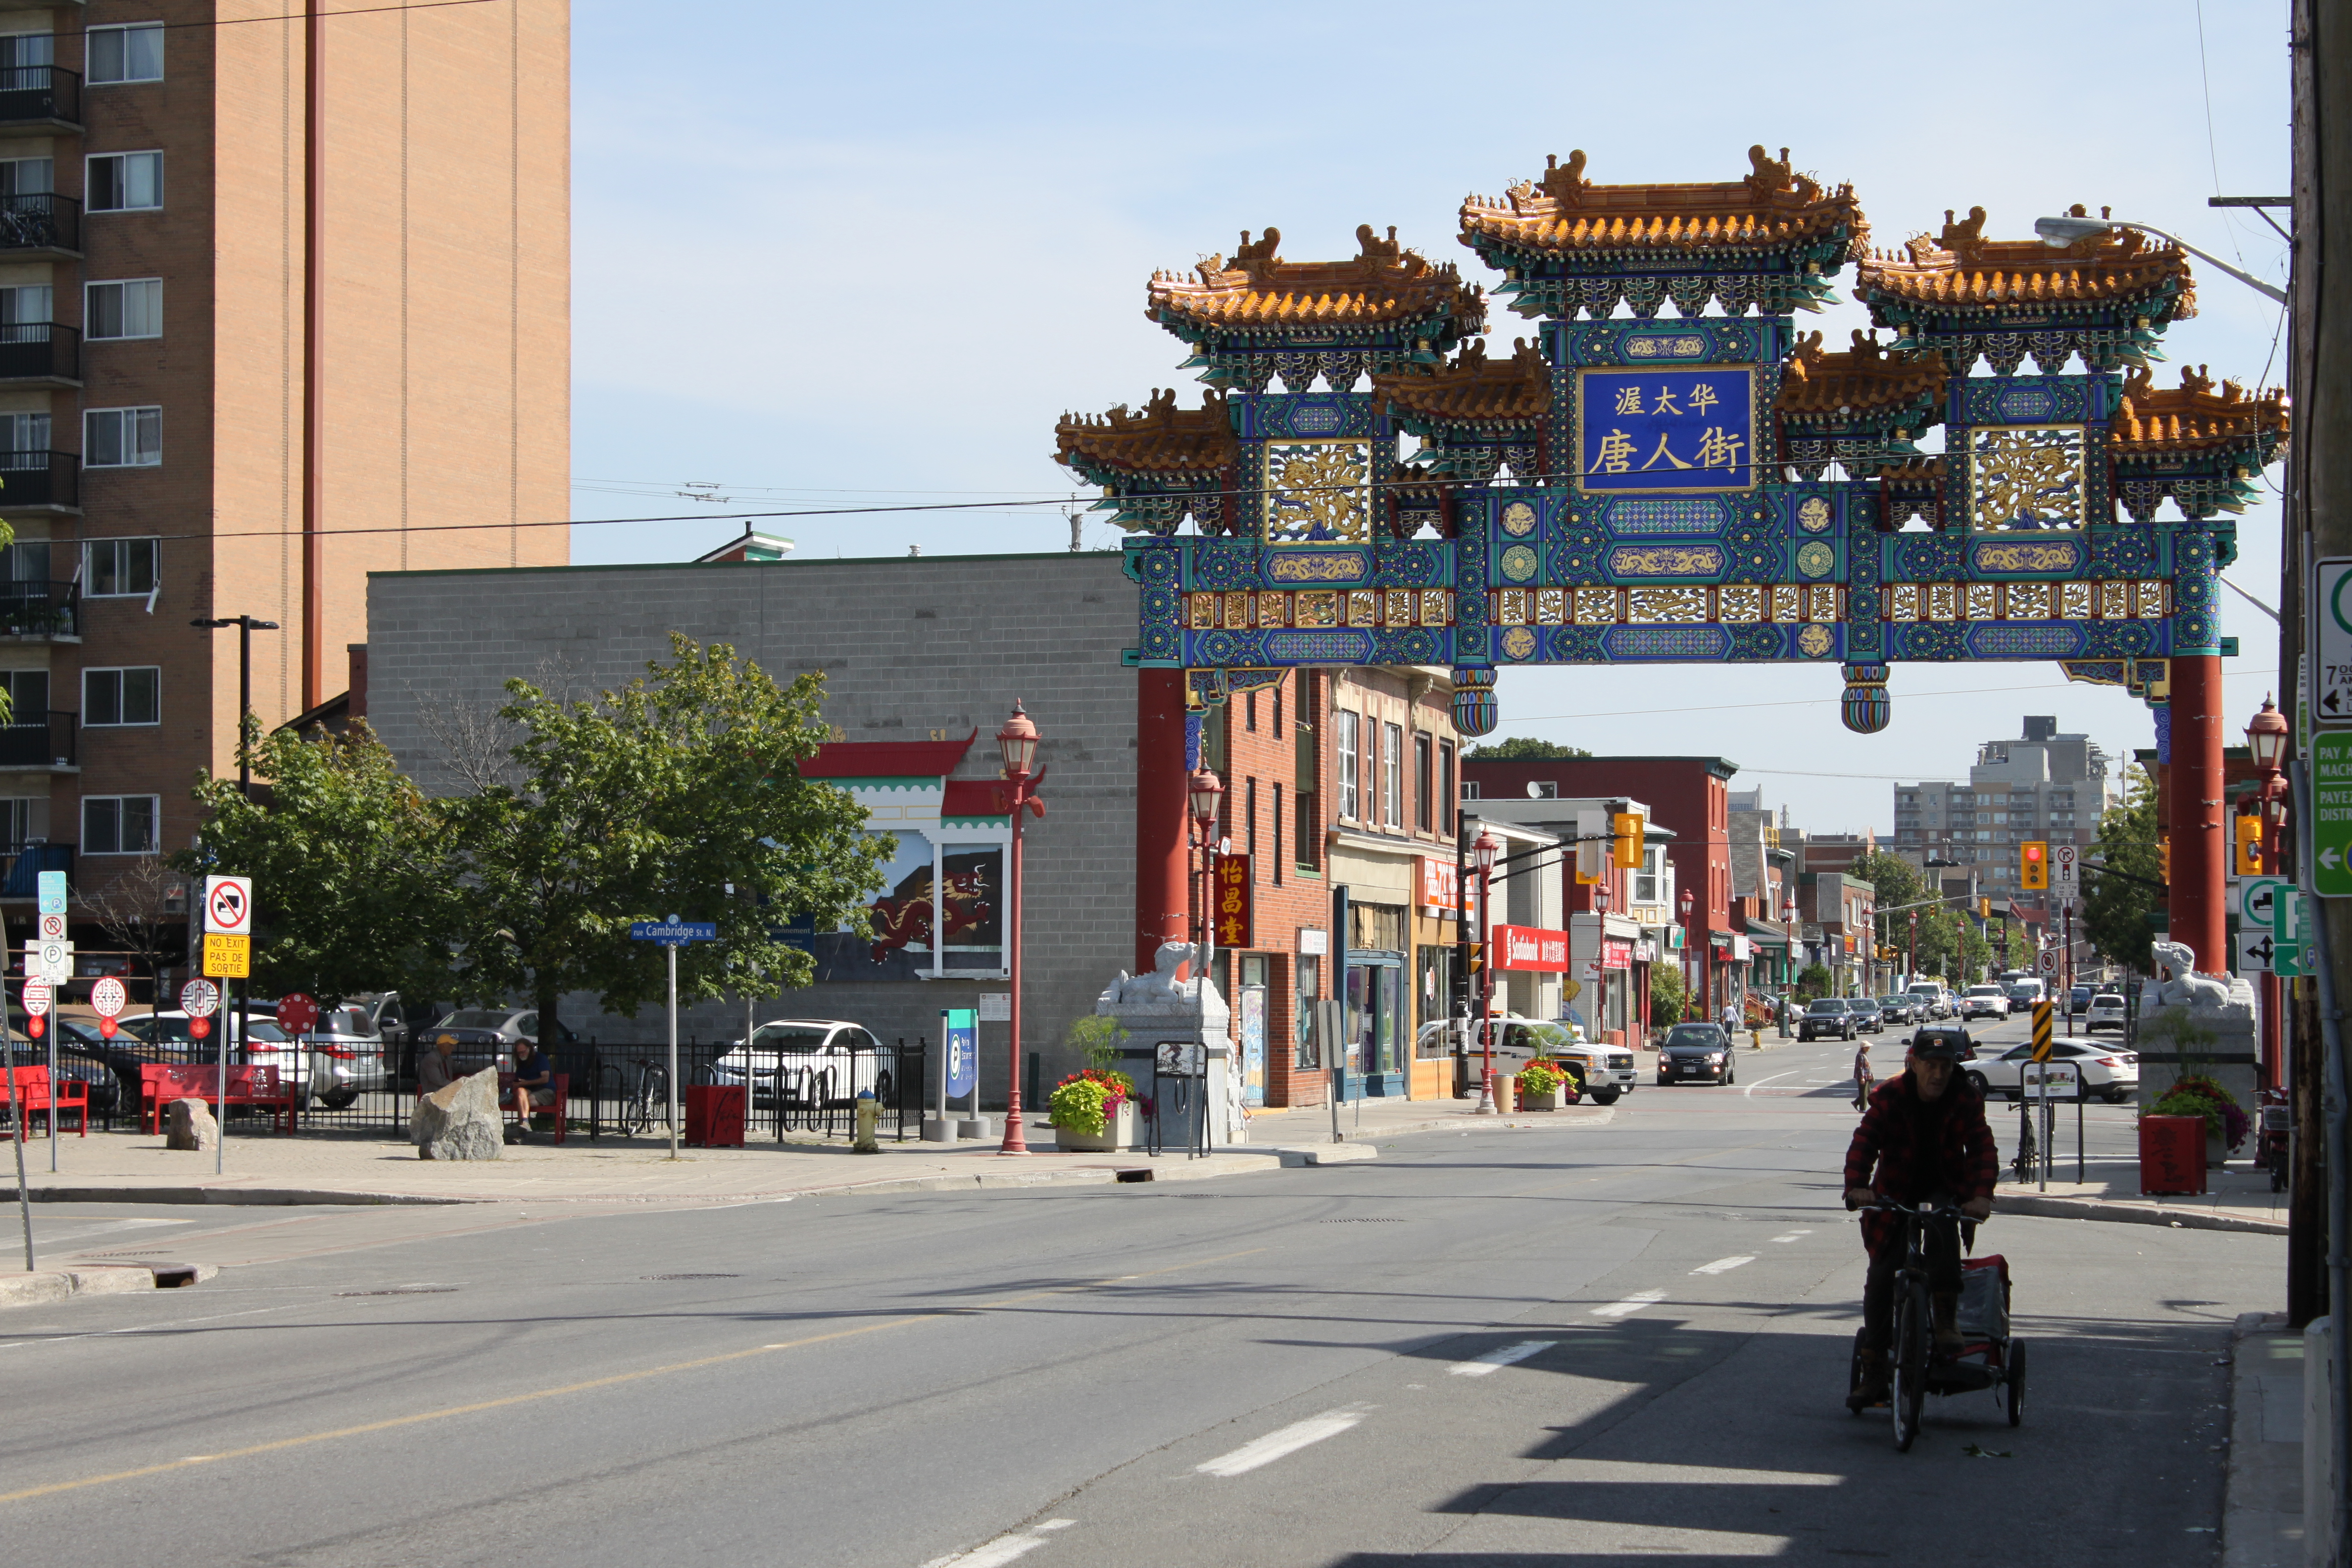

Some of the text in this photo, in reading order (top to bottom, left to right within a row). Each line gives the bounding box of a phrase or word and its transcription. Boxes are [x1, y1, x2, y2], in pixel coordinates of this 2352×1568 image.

[1615, 384, 1719, 417] 渥太华
[1588, 426, 1745, 475] 唐人街
[2326, 666, 2337, 685] 7
[2319, 747, 2341, 759] PAY
[1220, 859, 1243, 944] 怡昌堂
[646, 925, 693, 939] Cambridge
[210, 938, 245, 948] NO EXIT
[1513, 934, 1538, 961] Scotiabank
[210, 952, 243, 962] PAS DE
[211, 963, 242, 973] SORTIE
